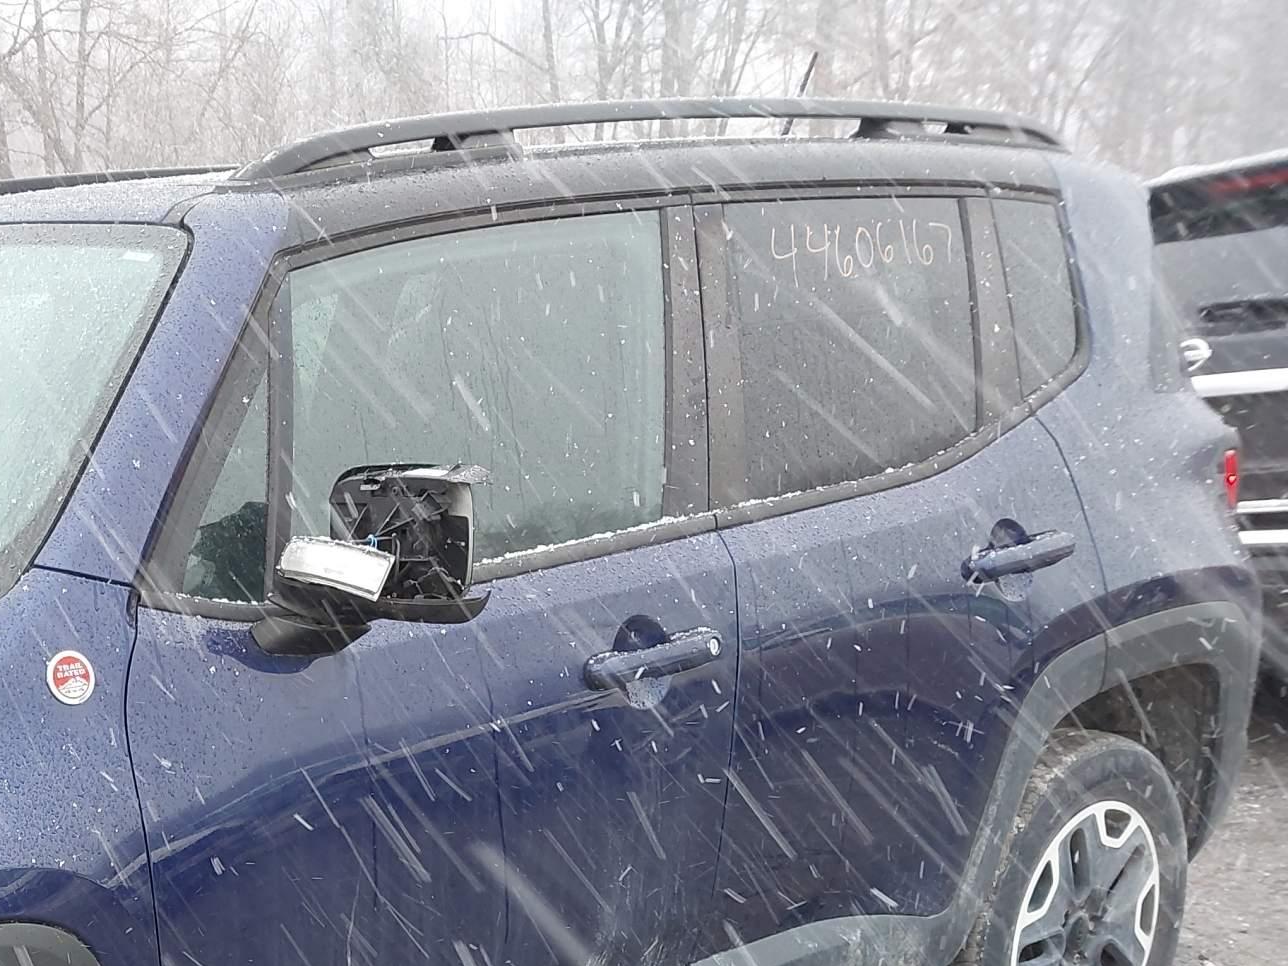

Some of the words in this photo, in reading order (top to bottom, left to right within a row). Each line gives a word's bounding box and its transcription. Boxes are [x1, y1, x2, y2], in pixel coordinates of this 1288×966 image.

[770, 219, 952, 289] 44606167
[56, 662, 83, 671] TRAIL
[56, 668, 86, 679] RATED
